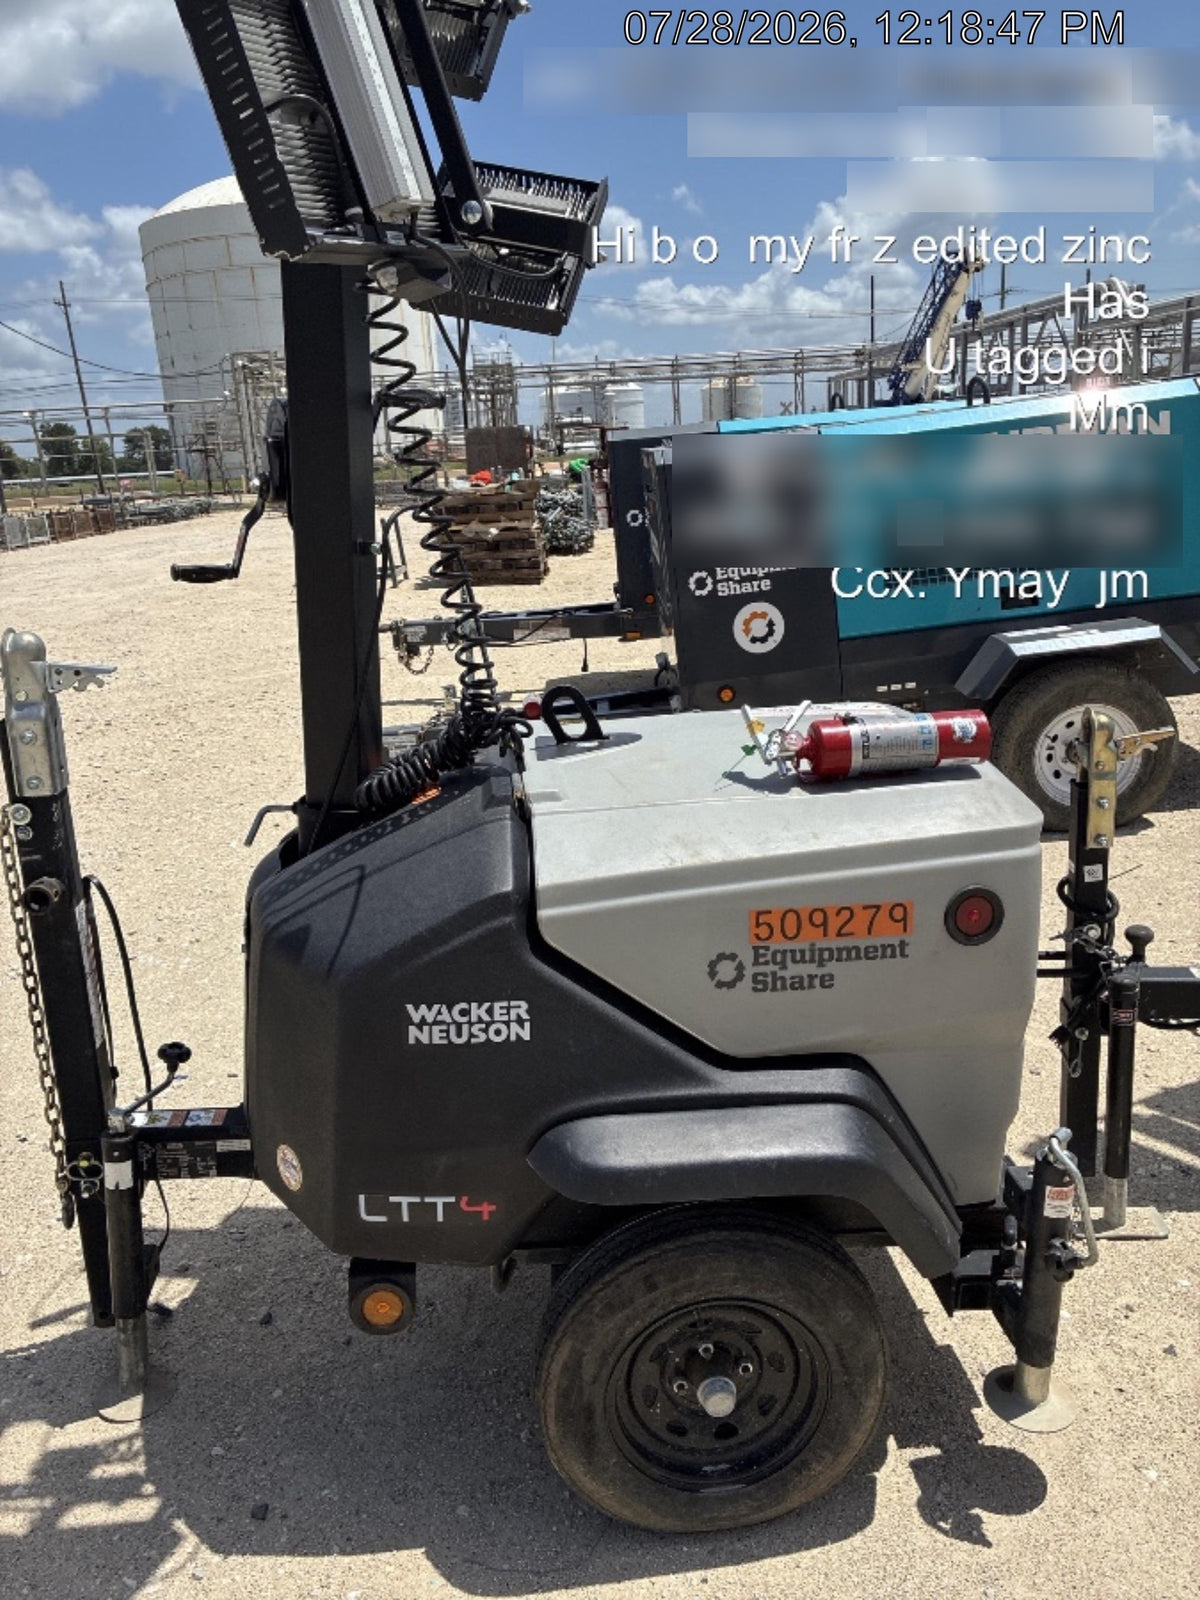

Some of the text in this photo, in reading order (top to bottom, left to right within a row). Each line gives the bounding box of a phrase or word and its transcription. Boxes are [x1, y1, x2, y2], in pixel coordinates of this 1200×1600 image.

[716, 578, 772, 597] Share
[753, 902, 909, 942] 509279
[751, 939, 910, 970] Equipment
[751, 970, 836, 994] Share
[404, 1000, 531, 1024] WACKER
[407, 1020, 531, 1045] NEUSON
[358, 1193, 497, 1222] LTT4
